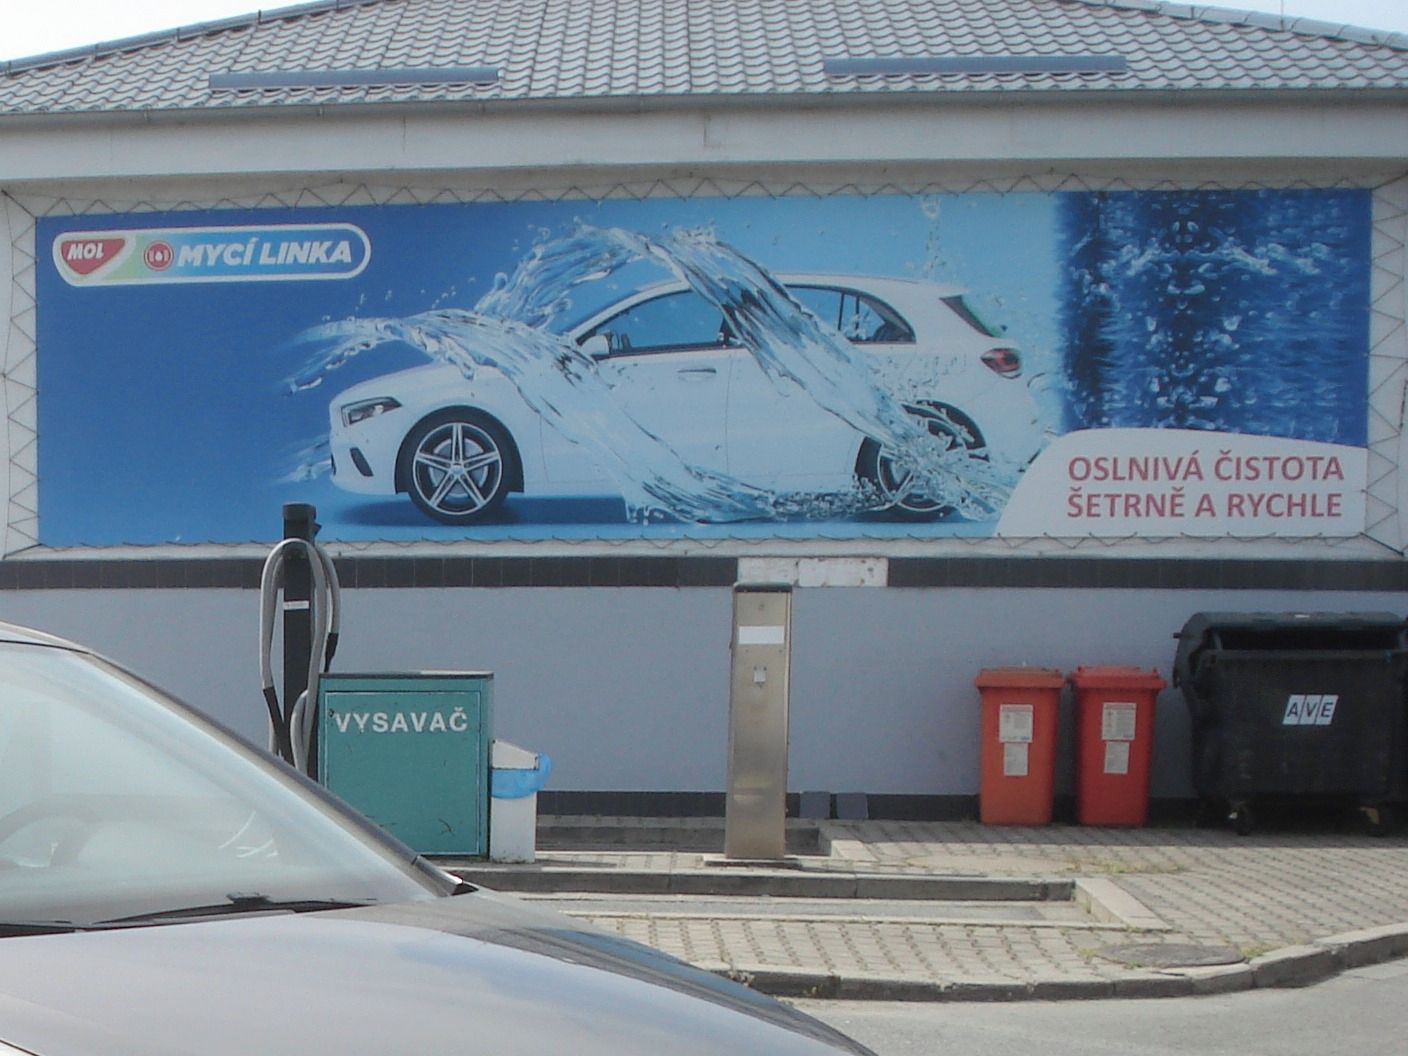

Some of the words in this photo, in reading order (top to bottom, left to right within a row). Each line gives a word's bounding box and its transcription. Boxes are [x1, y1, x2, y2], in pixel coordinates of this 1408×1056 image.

[66, 242, 105, 261] MOL
[176, 237, 259, 267] MYCÍ
[259, 240, 352, 265] LINKA
[1067, 449, 1204, 482] OSLNIVÁ
[1213, 449, 1345, 482] ČISTOTA
[1066, 486, 1186, 518] ŠETRNĚ
[1194, 493, 1217, 518] A
[1226, 493, 1343, 518] RYCHLE
[335, 706, 468, 733] VYSAVAČ
[1286, 702, 1334, 718] AVE
